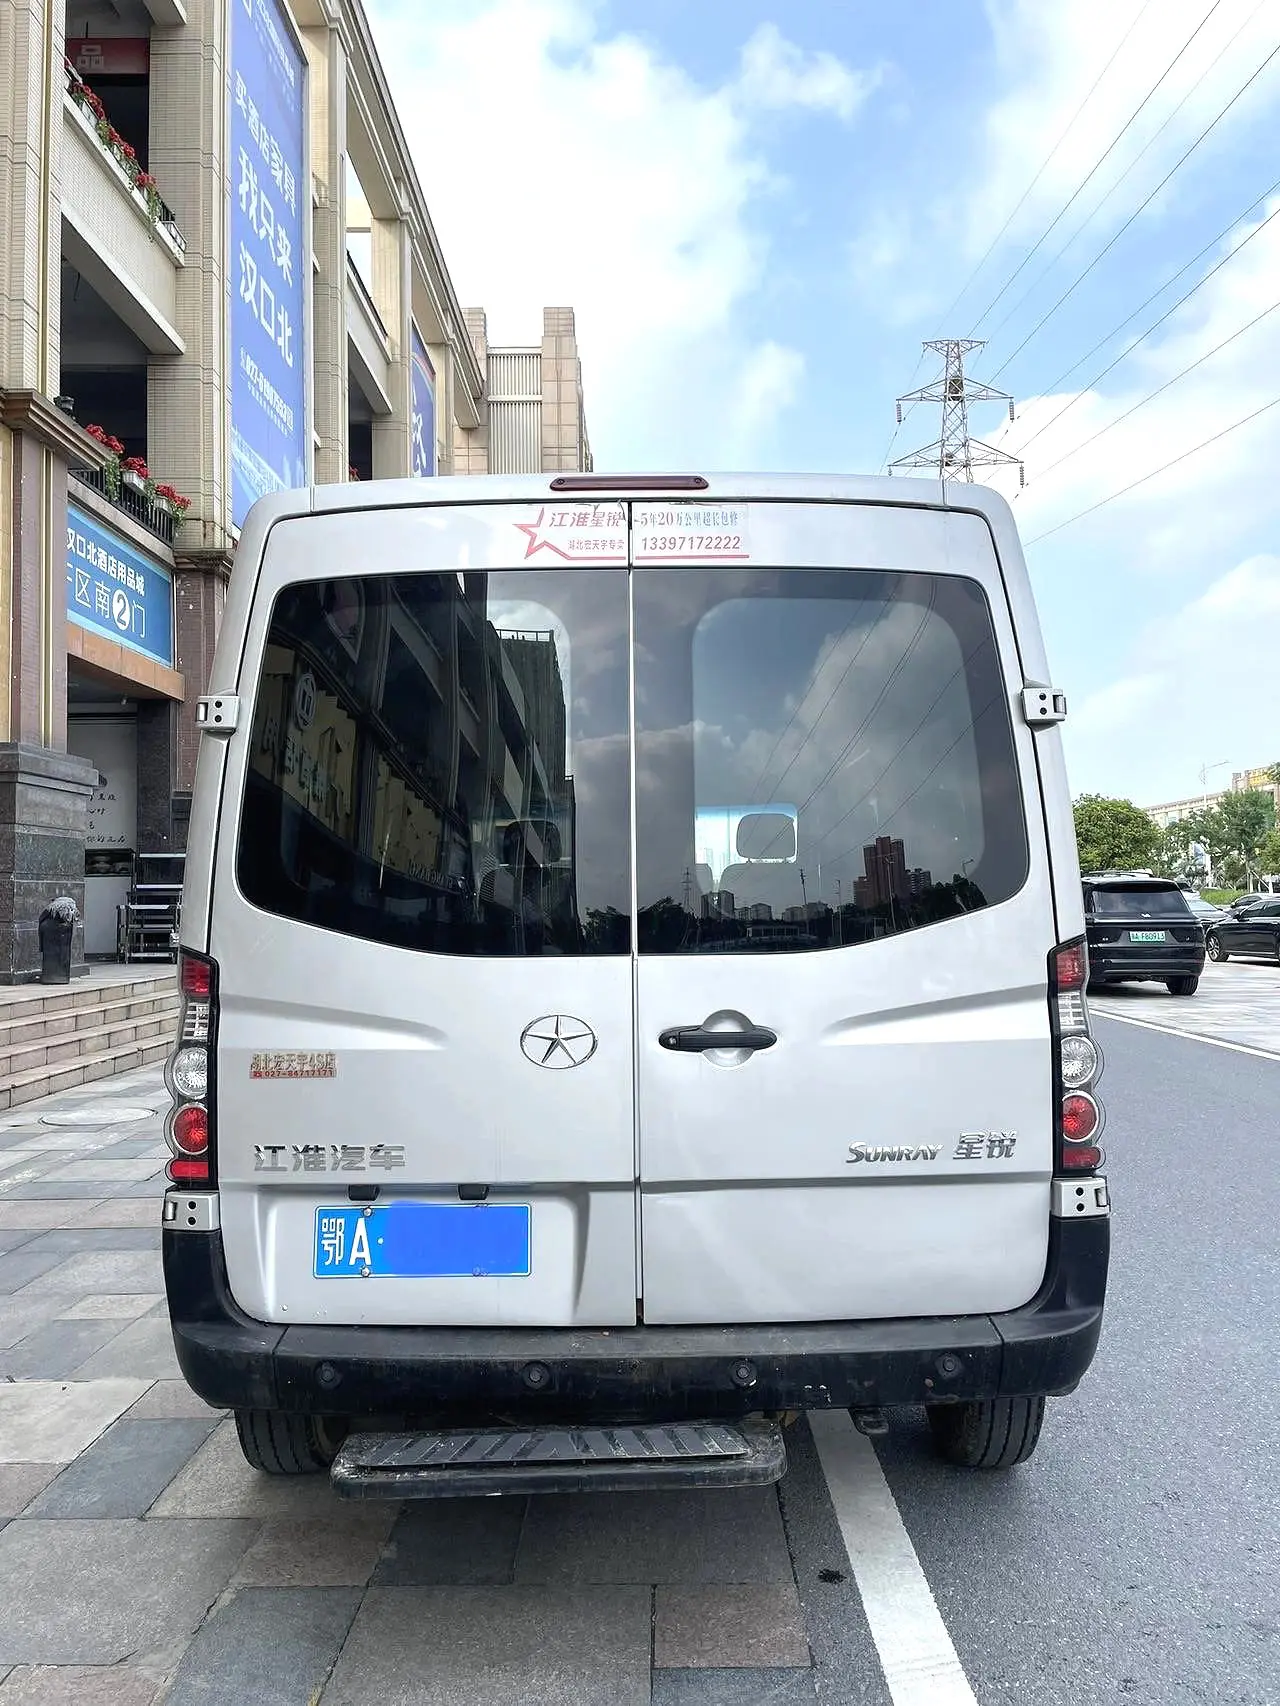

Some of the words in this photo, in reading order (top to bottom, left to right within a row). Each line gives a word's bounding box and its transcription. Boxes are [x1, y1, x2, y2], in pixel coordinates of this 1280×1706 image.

[238, 145, 293, 288] 我只来
[239, 240, 293, 368] 汉口北
[548, 511, 625, 528] 江淮星锐
[641, 535, 741, 551] 13397172222
[254, 1143, 405, 1172] 江淮汽车
[953, 1130, 1018, 1160] 星锐
